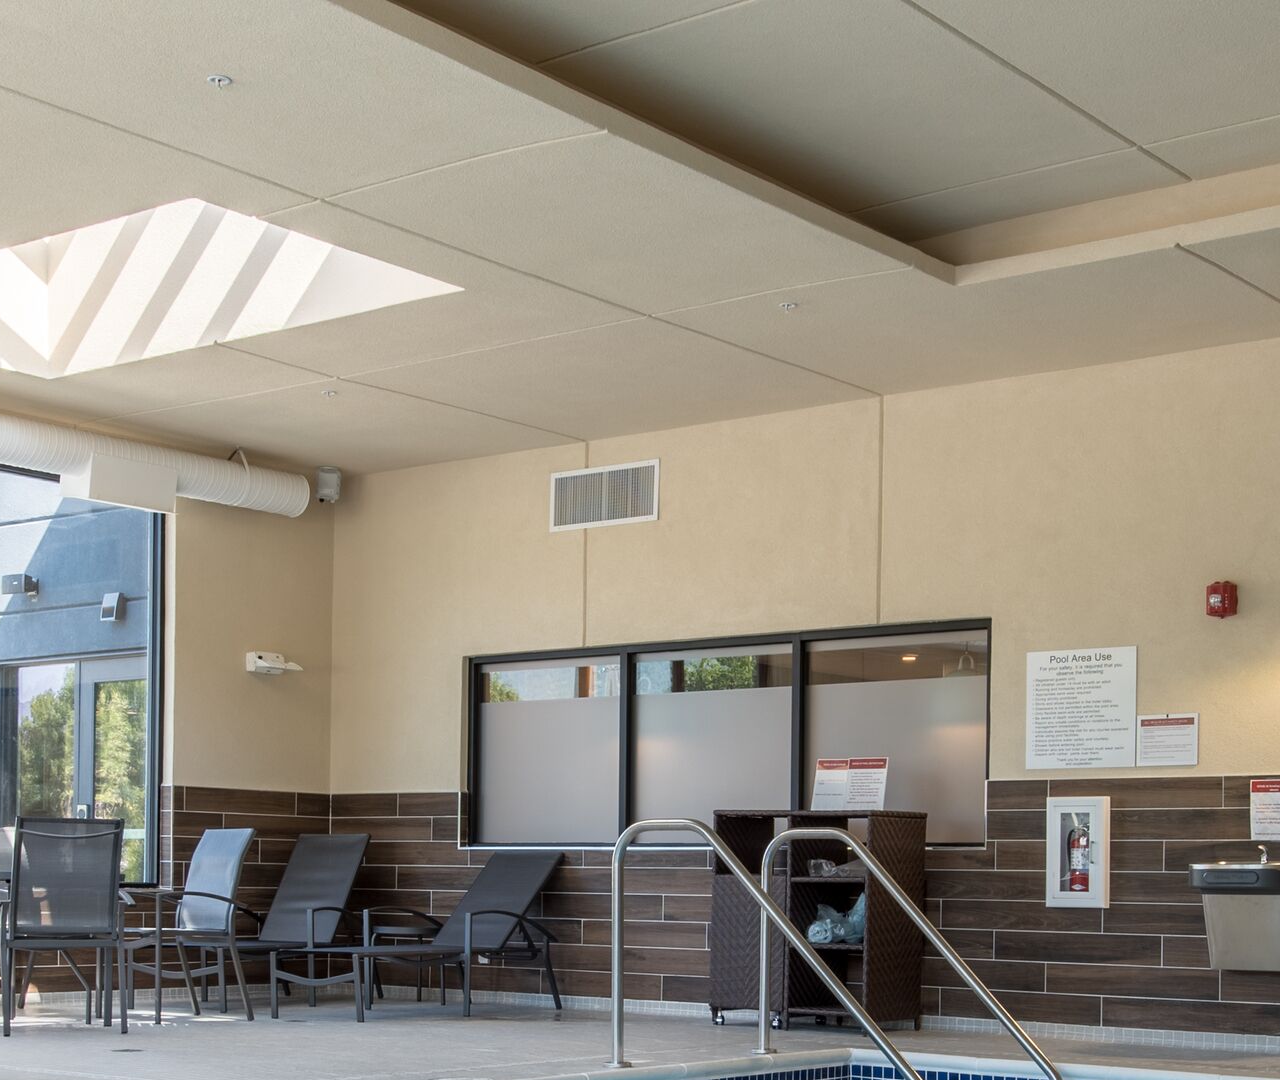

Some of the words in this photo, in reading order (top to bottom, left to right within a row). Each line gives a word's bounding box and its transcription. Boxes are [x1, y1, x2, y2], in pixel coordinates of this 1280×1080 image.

[1049, 656, 1069, 664] Pool
[1071, 654, 1092, 662] Area
[1095, 653, 1112, 661] Use
